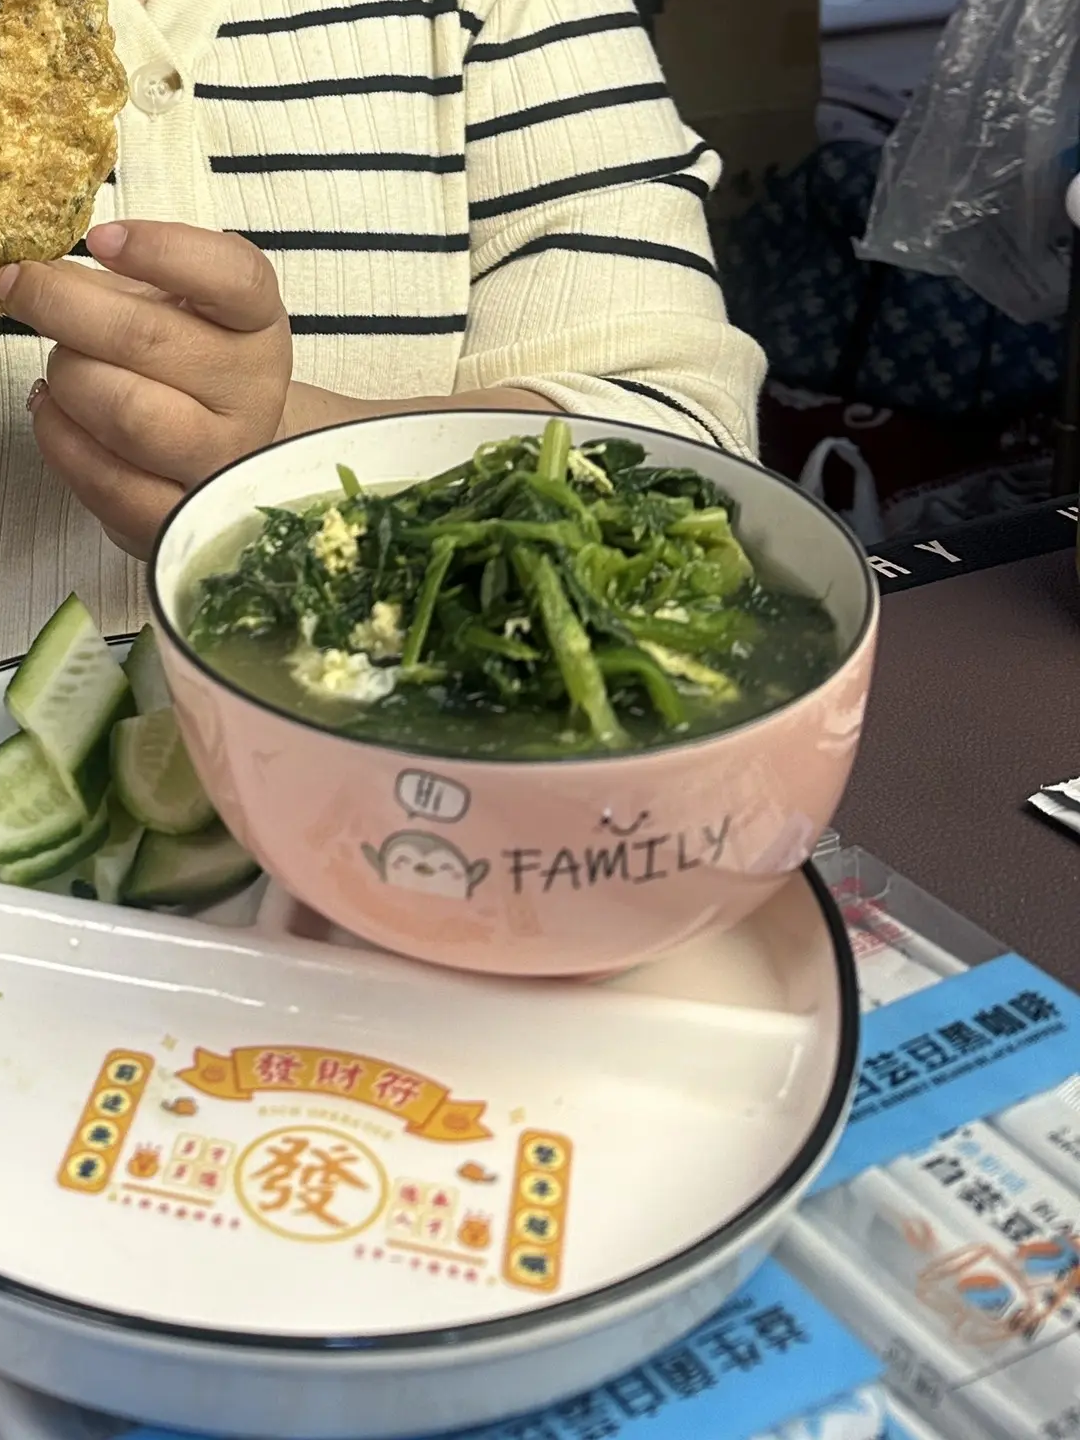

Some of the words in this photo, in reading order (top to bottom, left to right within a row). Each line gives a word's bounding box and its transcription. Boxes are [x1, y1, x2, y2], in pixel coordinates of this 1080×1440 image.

[501, 814, 732, 895] FAMILY
[253, 1052, 427, 1109] 發財符
[250, 1136, 372, 1230] 發
